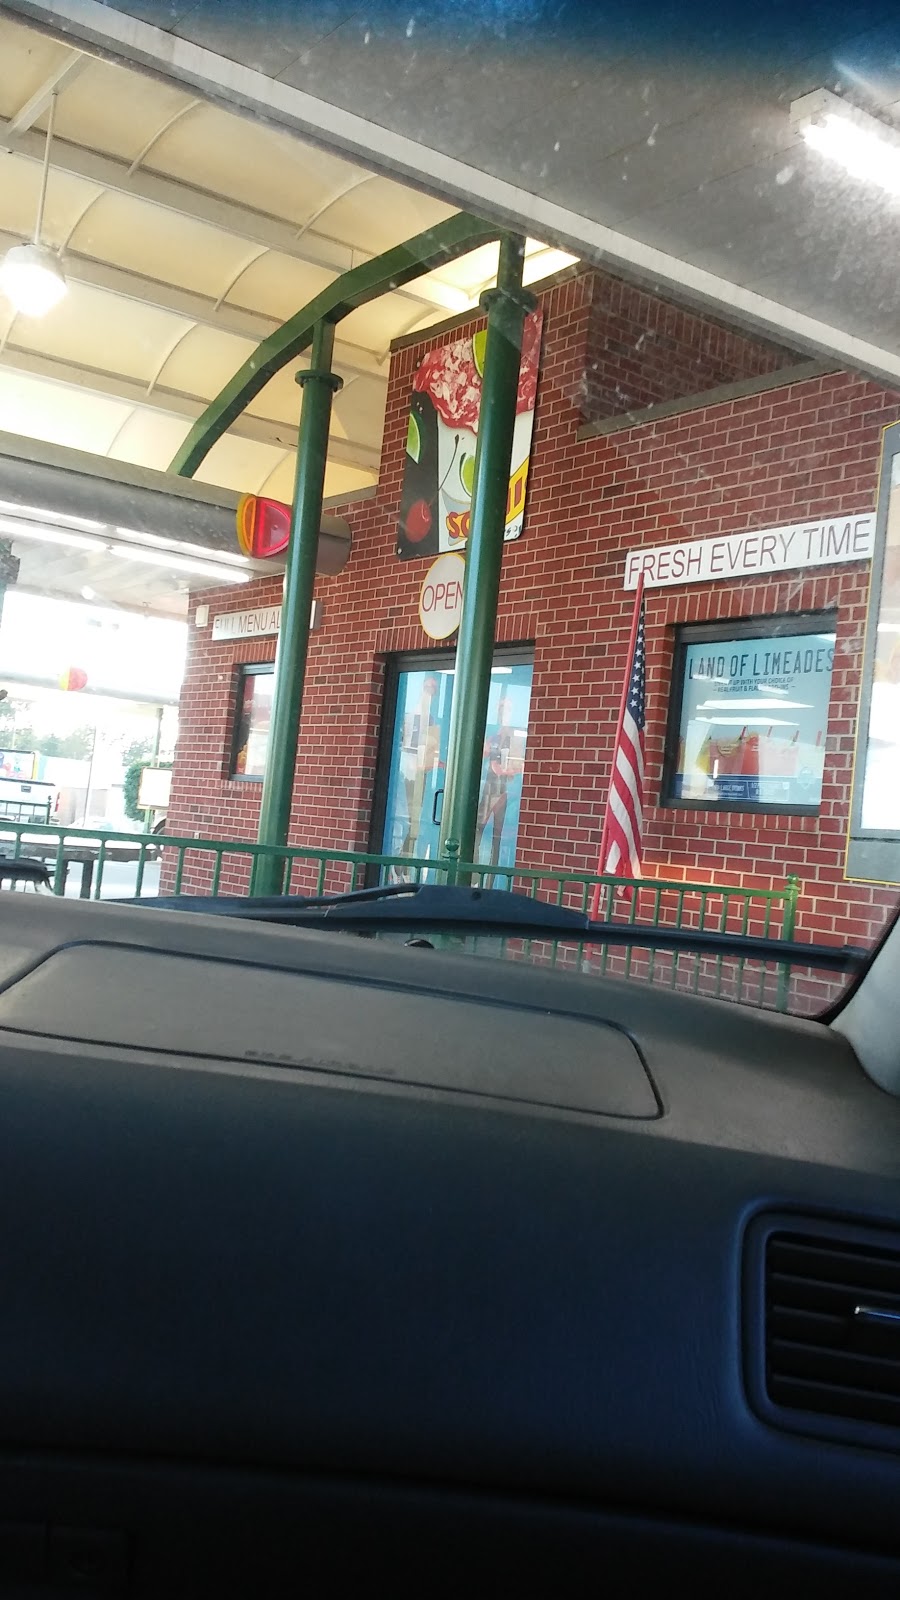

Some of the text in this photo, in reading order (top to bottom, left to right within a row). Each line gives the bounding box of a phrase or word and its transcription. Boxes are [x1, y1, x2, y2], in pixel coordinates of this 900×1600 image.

[628, 518, 871, 584] FRESH EVERY TIME
[422, 581, 463, 612] OPEN
[239, 612, 268, 633] MENU
[269, 610, 281, 629] AL
[689, 648, 834, 679] LAND OF LIMEADES
[740, 678, 754, 686] WITH
[767, 677, 786, 685] CHOICE
